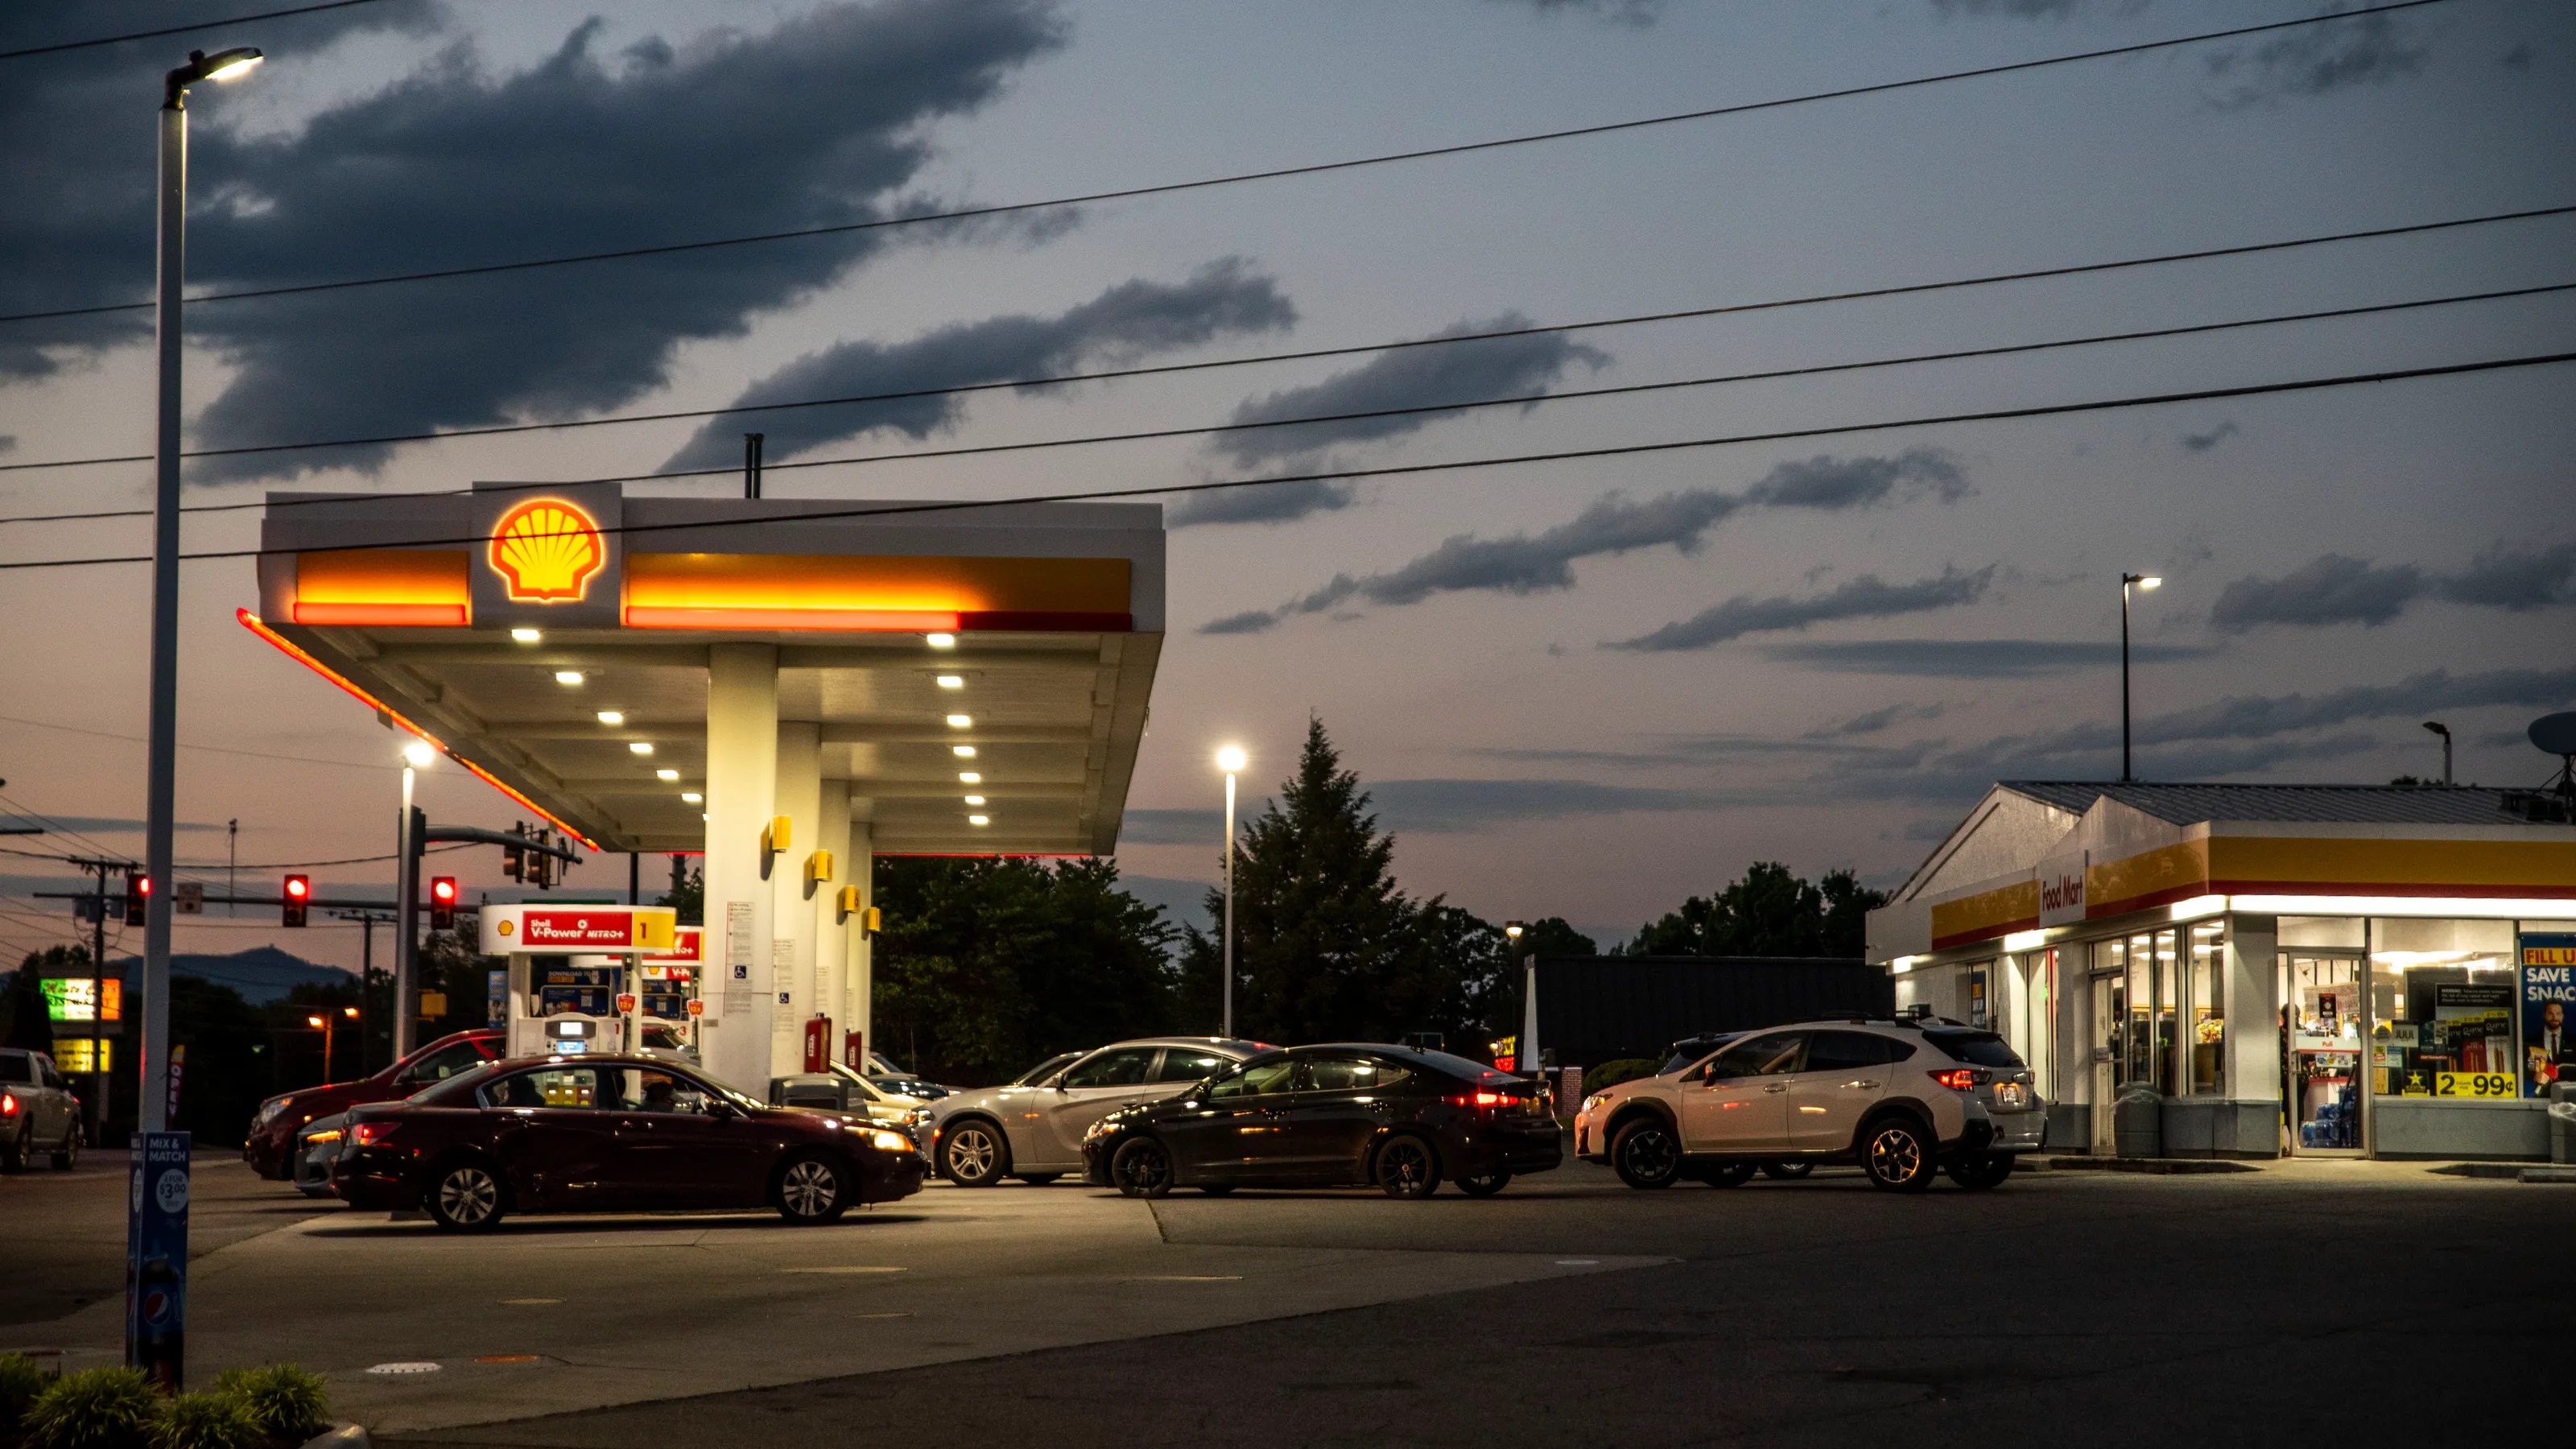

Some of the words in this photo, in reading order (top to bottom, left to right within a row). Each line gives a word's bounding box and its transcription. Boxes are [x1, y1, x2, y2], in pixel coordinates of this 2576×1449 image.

[2042, 874, 2061, 911] Food
[2062, 875, 2083, 907] Mart
[530, 919, 551, 927] Shell
[530, 927, 583, 938] V-Power
[640, 923, 646, 939] 1
[2525, 950, 2557, 964] FILL
[2527, 968, 2570, 982] SAVE
[615, 1024, 619, 1034] 1
[679, 1026, 686, 1036] 3
[2395, 1030, 2414, 1039] JUUL
[2440, 1075, 2455, 1095] 2
[2473, 1075, 2513, 1095] 99¢
[150, 1138, 170, 1149] MIX
[171, 1138, 180, 1149] &
[149, 1151, 186, 1162] MATCH
